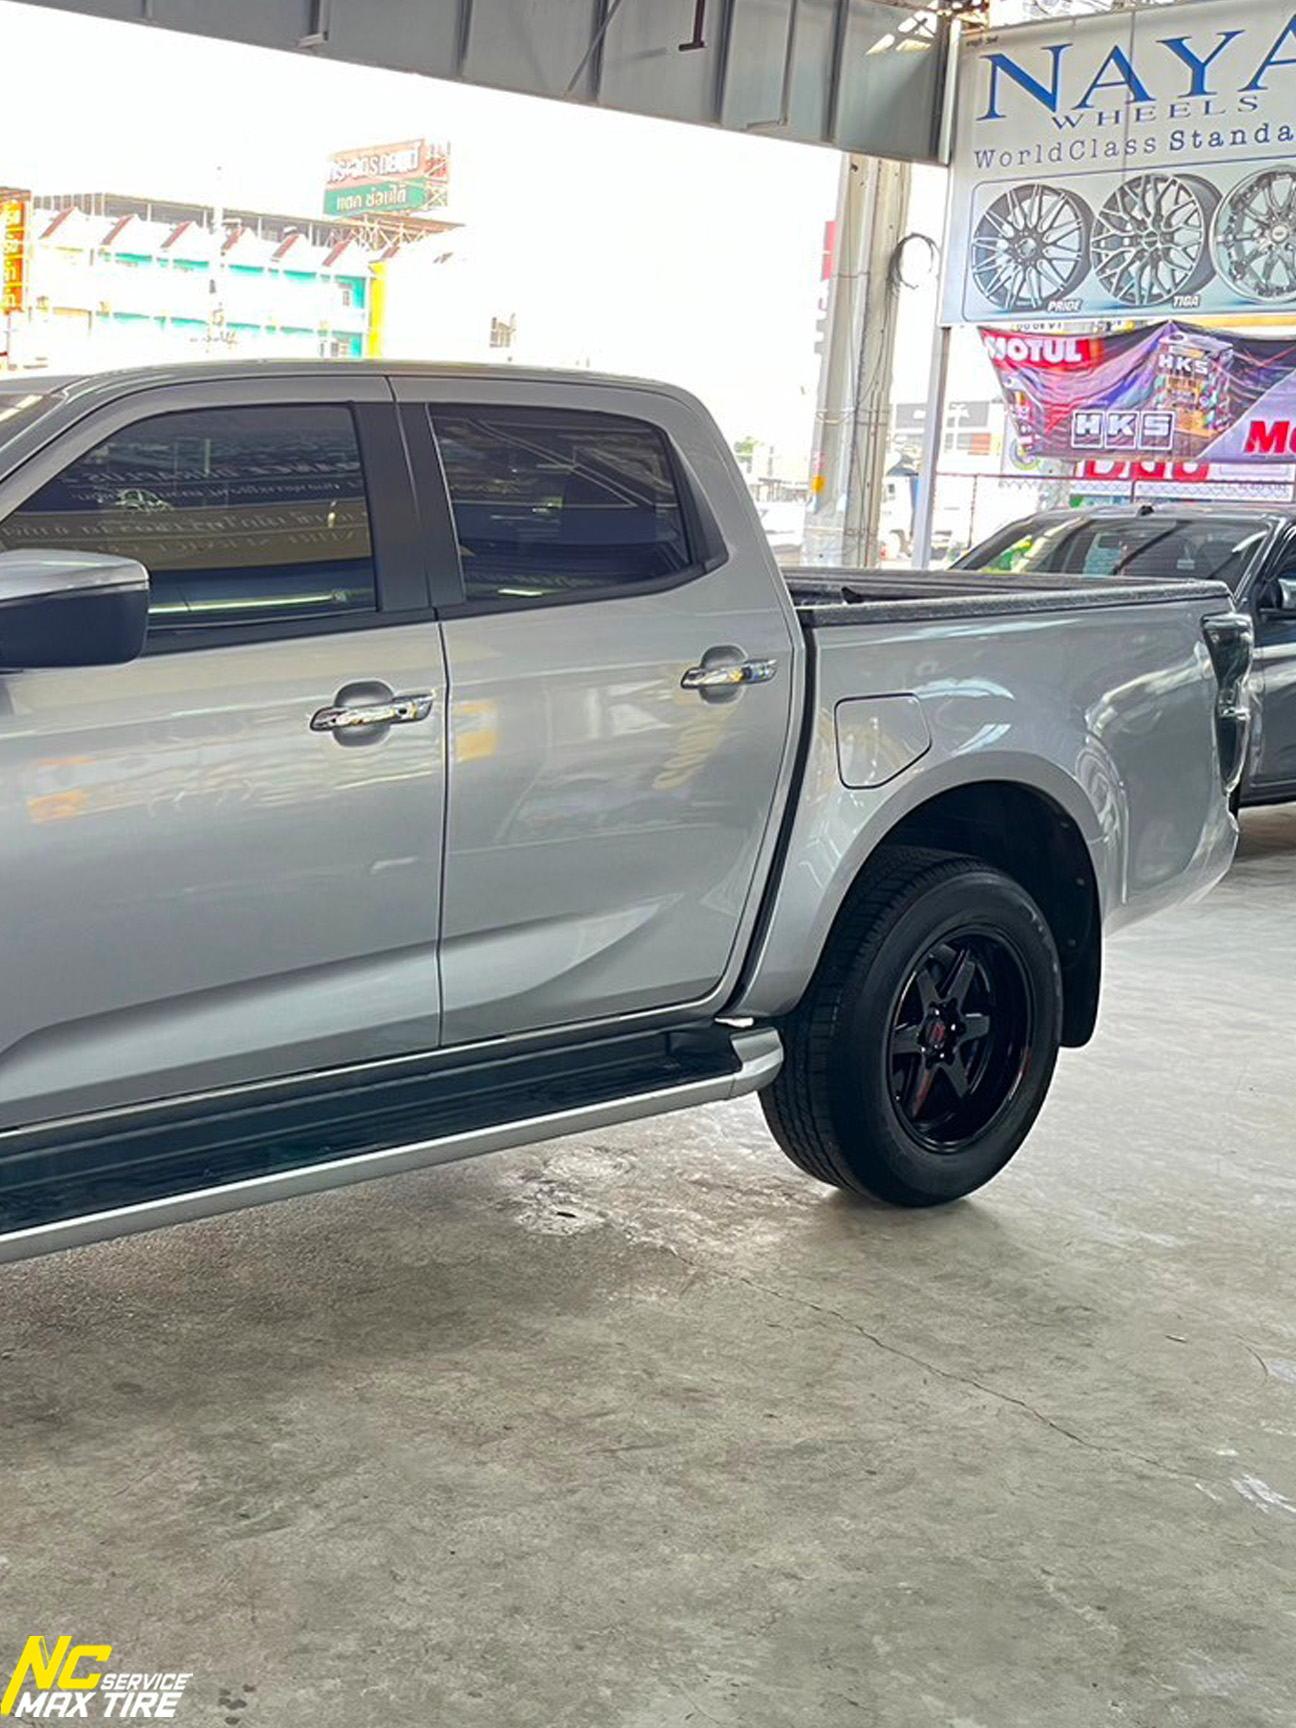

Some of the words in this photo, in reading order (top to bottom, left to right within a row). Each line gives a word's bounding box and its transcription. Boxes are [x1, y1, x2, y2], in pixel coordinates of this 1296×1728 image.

[1052, 96, 1259, 131] WHEELS
[974, 138, 1157, 170] WorldClass
[1047, 299, 1082, 313] PRIDE
[984, 336, 1083, 363] MOTUL
[1158, 353, 1209, 375] HKS
[1074, 411, 1173, 441] HKS
